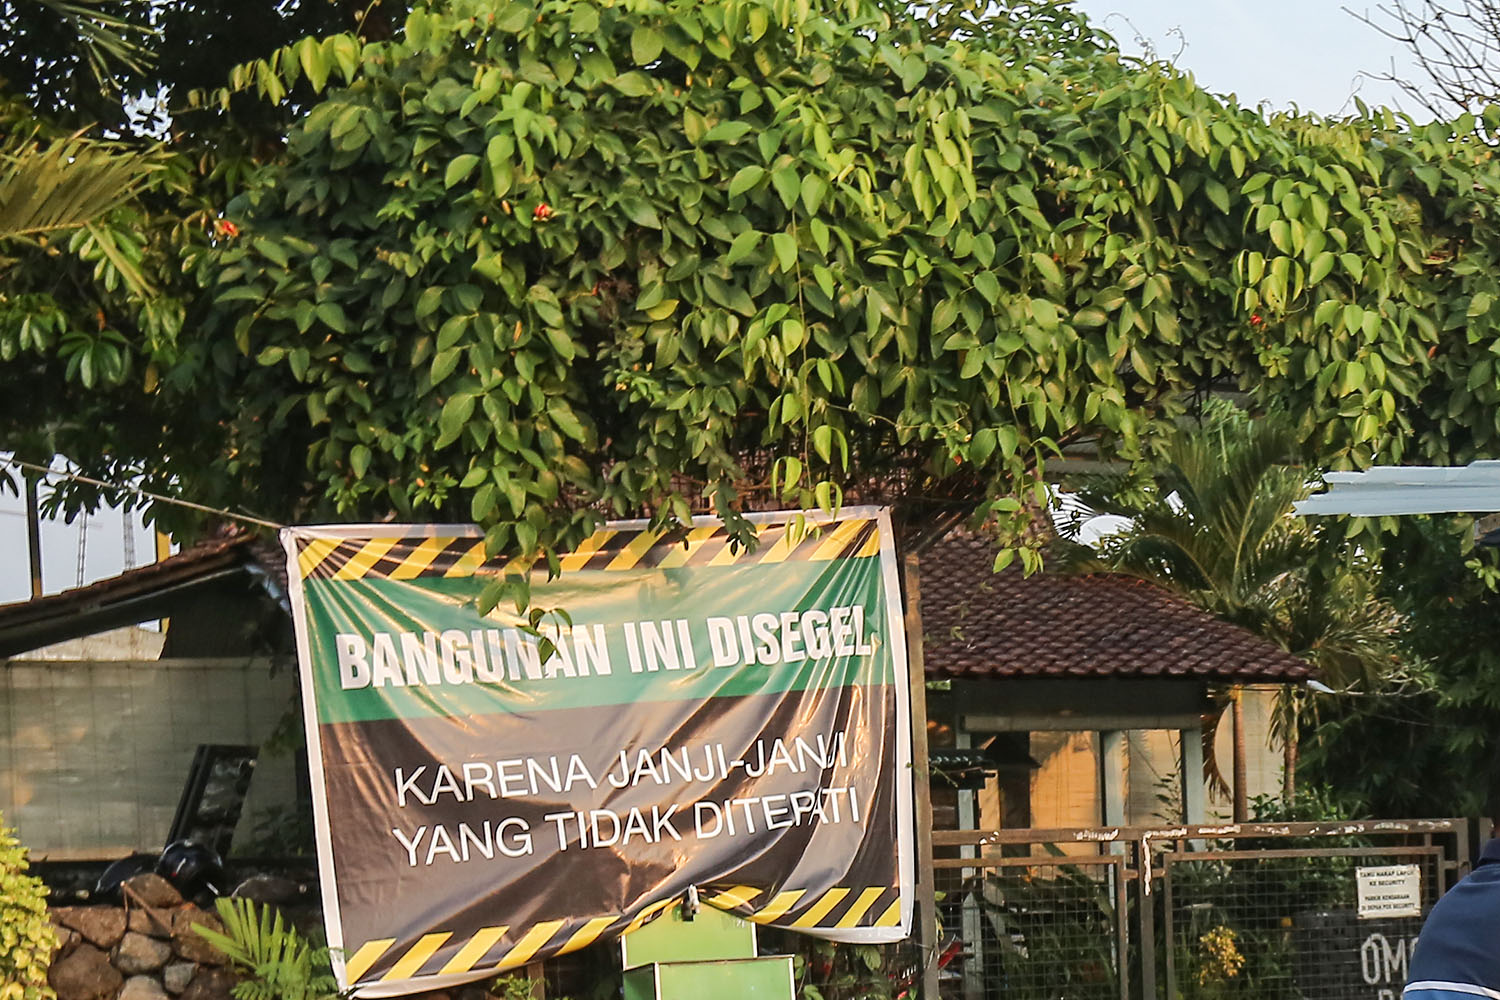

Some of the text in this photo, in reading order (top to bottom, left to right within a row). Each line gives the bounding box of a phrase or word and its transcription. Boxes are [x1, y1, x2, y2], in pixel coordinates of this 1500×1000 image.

[336, 605, 872, 690] BANGUNAN INI DISEGEL
[394, 731, 848, 808] KARENA JANJI-JANJI
[392, 786, 860, 867] YANG TIDAK DITEPATI
